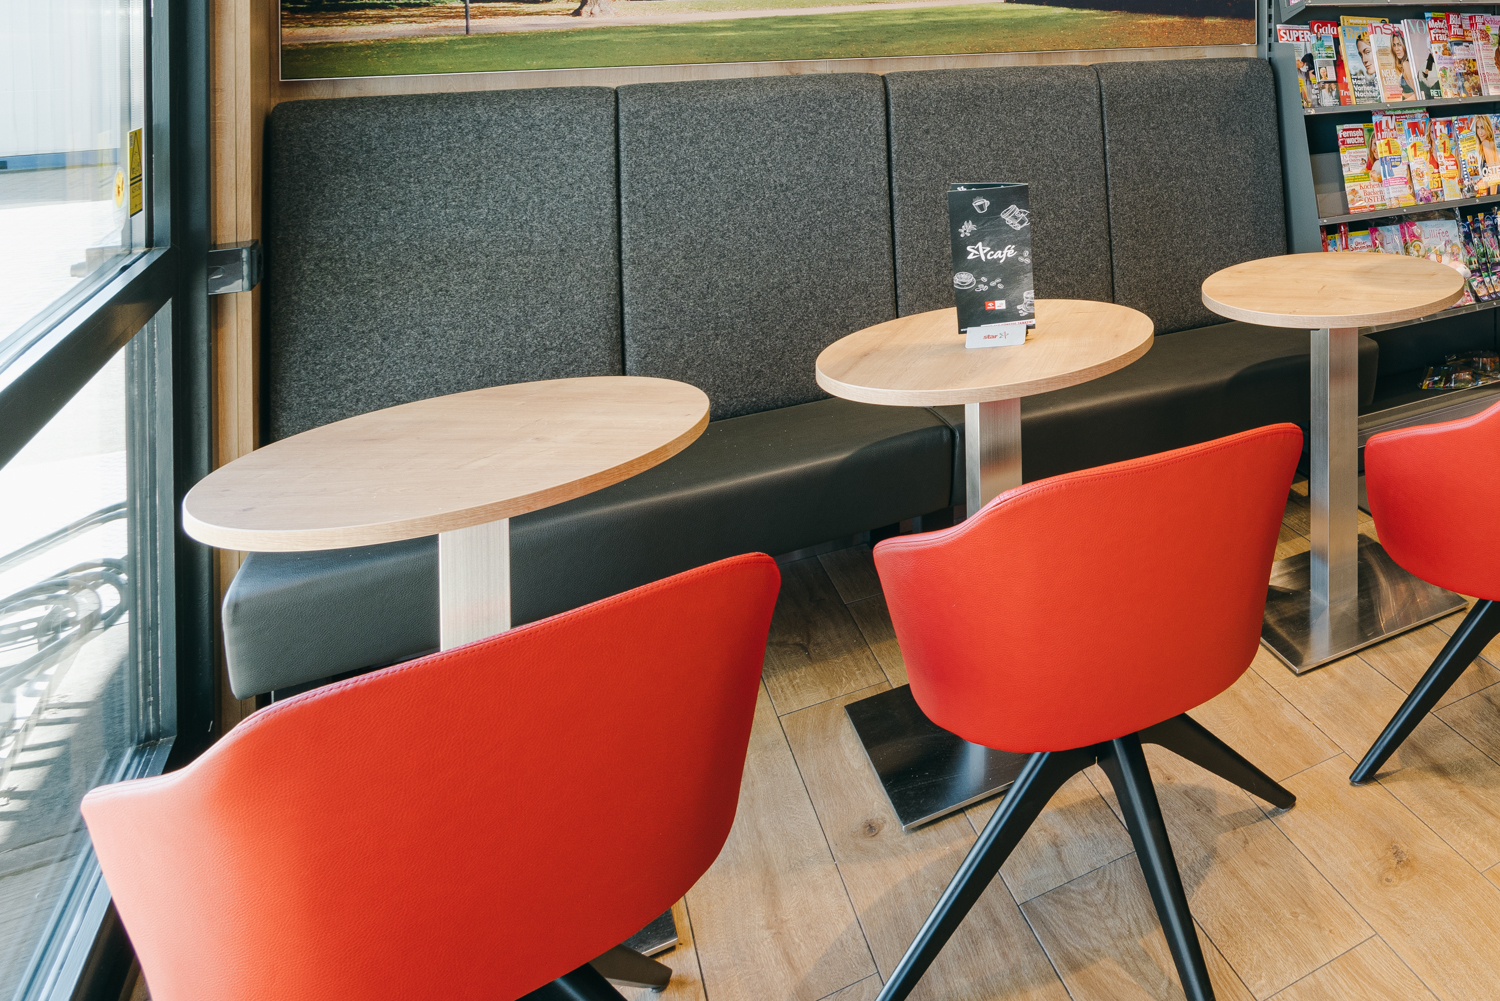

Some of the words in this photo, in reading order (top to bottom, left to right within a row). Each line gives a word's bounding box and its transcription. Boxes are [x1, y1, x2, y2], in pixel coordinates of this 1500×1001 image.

[1280, 29, 1311, 42] SUPER
[1314, 22, 1338, 35] Gala
[1345, 27, 1370, 43] Brig
[1370, 23, 1404, 37] InSty
[1382, 114, 1396, 130] TV
[1407, 121, 1426, 137] TV
[987, 245, 1017, 263] café
